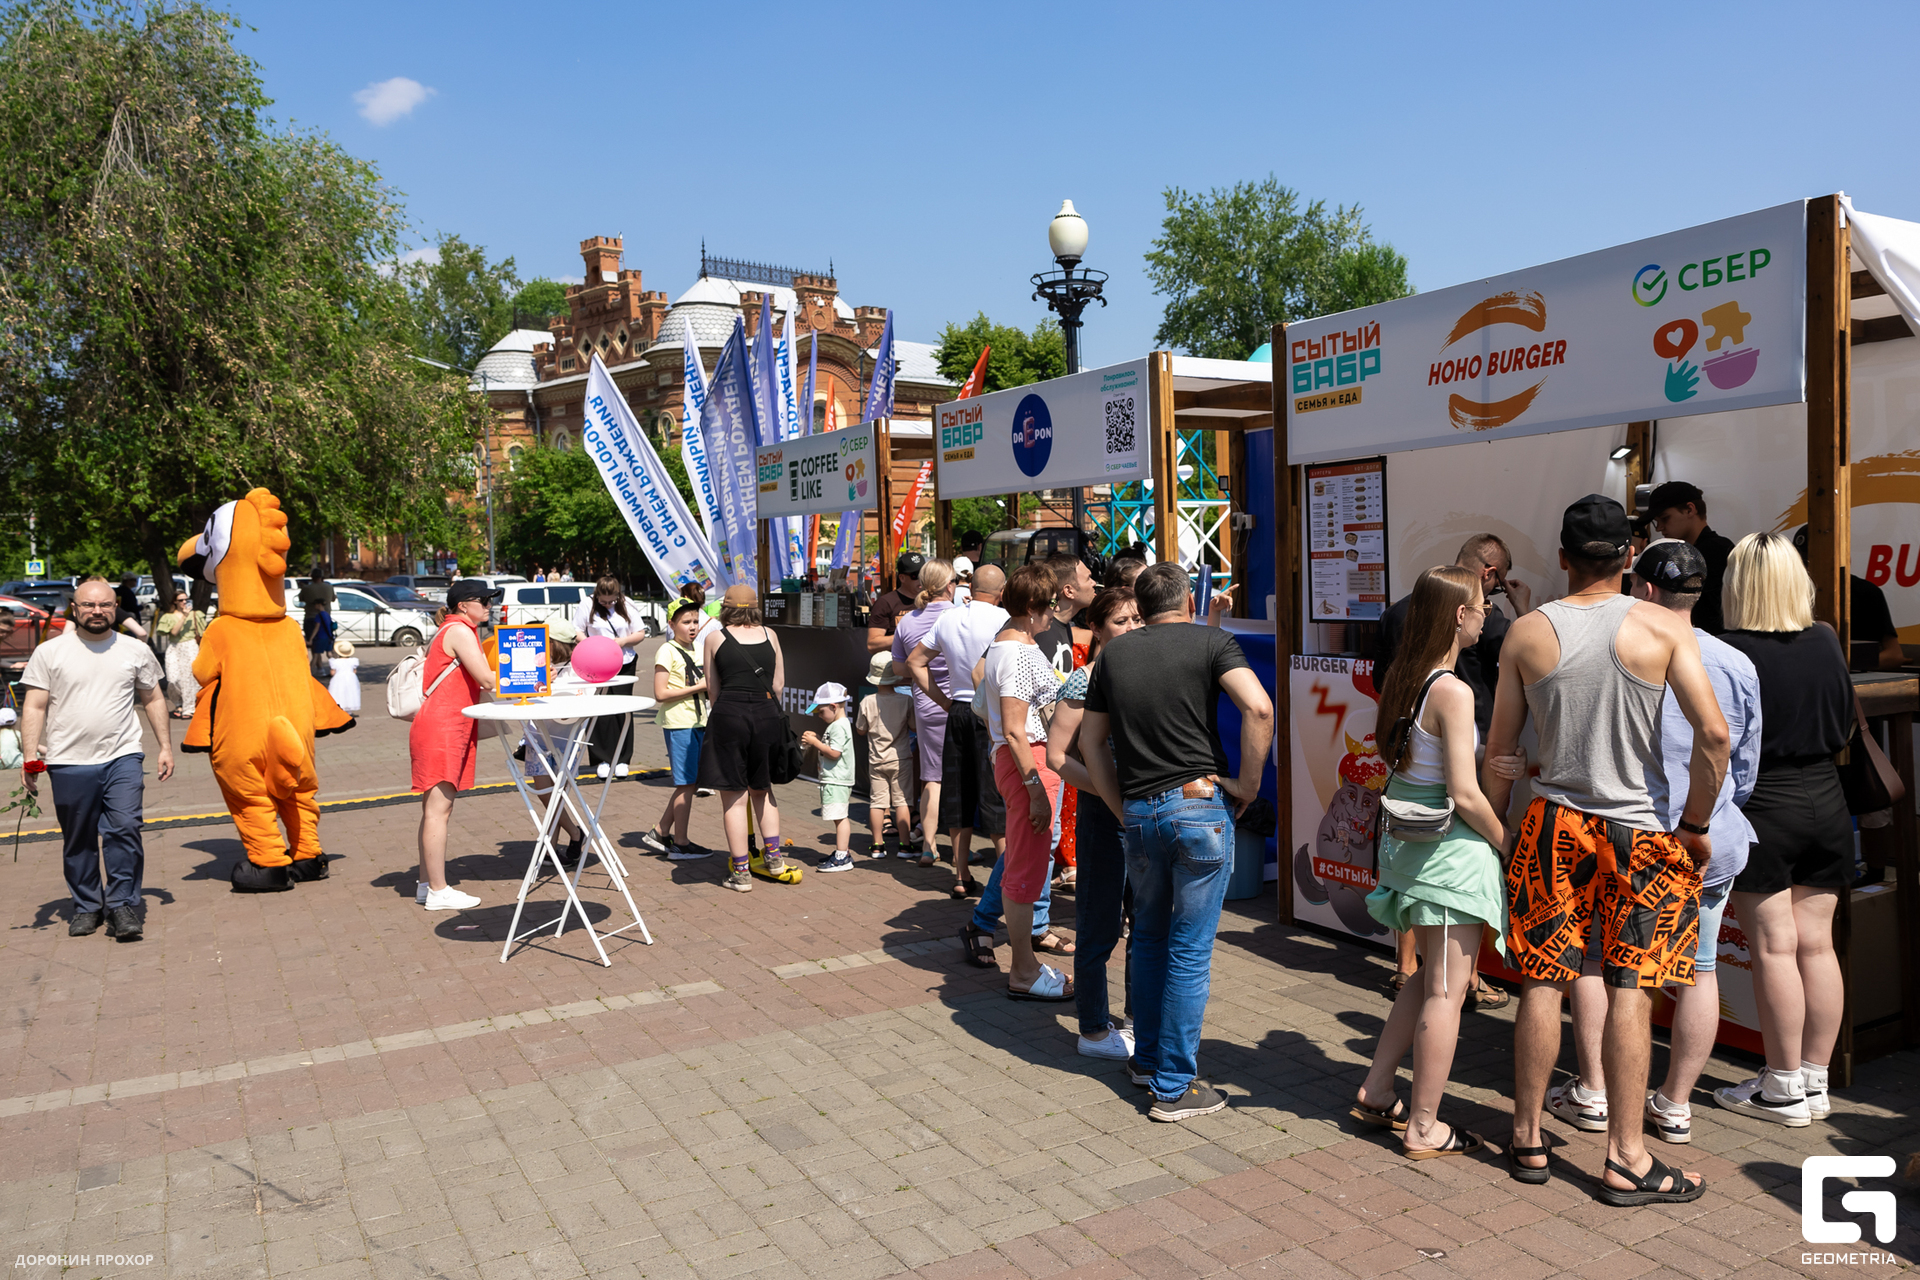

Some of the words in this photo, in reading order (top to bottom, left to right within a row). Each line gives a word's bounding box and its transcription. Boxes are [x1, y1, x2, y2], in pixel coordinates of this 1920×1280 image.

[1678, 248, 1771, 291] СБЕР
[1292, 320, 1380, 364] СЫТЫЙ
[1293, 348, 1381, 394] БАБР
[1427, 355, 1482, 386] HOHO
[1487, 340, 1567, 376] BURGER
[1100, 378, 1139, 393] обслуживание?
[1103, 370, 1136, 382] Понравилось
[1297, 397, 1327, 411] СЕМЬЯ
[1339, 392, 1357, 404] ЕДА
[942, 404, 982, 428] СЫТЫЙ
[849, 436, 868, 451] СБЕР
[942, 423, 983, 449] БАБР
[759, 448, 783, 467] СЫТЫЙ
[801, 452, 838, 477] COFFEE
[944, 452, 959, 460] СЕМЬЯ
[964, 450, 973, 458] ЕДА
[759, 463, 783, 482] БАБР
[1121, 461, 1137, 469] ЧАЕВЫЕ
[802, 479, 822, 500] LIKE
[769, 600, 785, 608] COFFEE
[769, 609, 779, 617] LIKE
[1511, 838, 1530, 879] GIVE
[1525, 814, 1537, 837] UP
[1556, 830, 1575, 852] UP
[1538, 911, 1552, 922] READY
